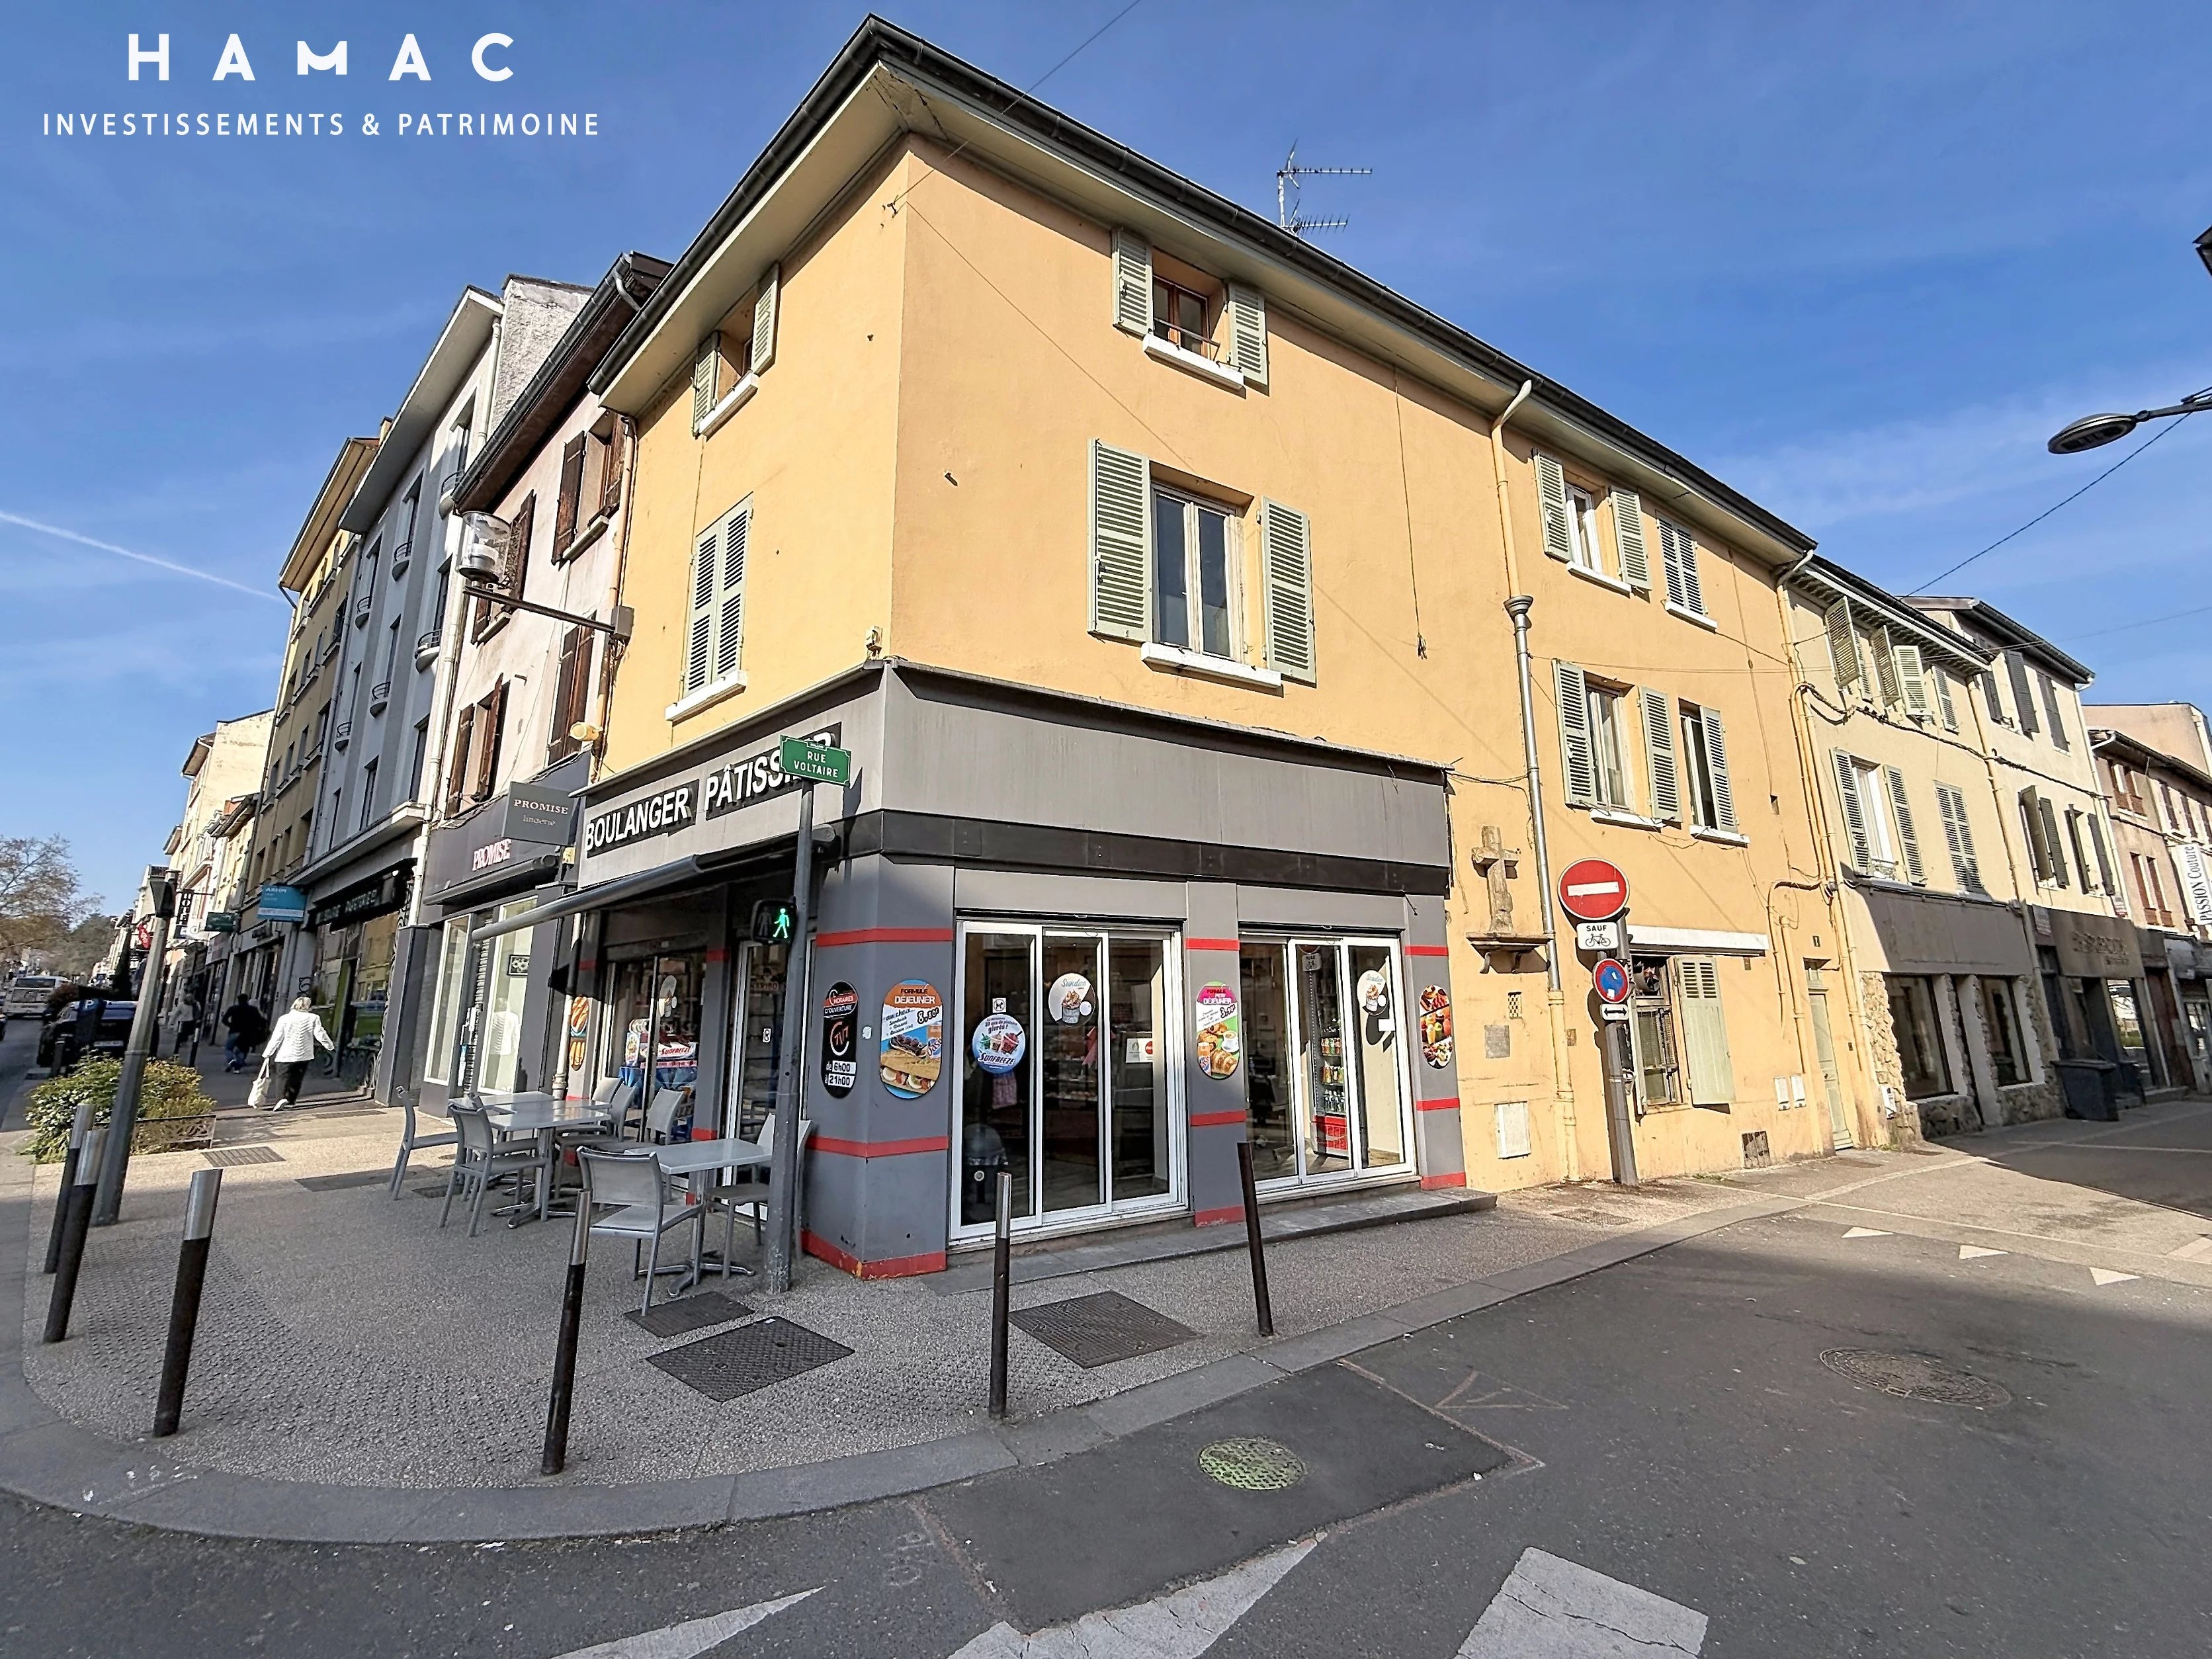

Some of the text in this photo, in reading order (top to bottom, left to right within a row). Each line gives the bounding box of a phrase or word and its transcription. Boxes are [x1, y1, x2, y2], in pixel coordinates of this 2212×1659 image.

[807, 751, 826, 763] RUE
[794, 760, 839, 778] VOLTAIRE
[585, 732, 831, 851] BOULANGER PÂTISS
[514, 799, 568, 815] PROMISE
[472, 838, 512, 871] PROMISE
[2184, 846, 2212, 921] PASSION Couture
[833, 996, 854, 1004] HORAIRES
[825, 1005, 853, 1014] D'OUVERTURE
[979, 1052, 1015, 1064] SUNFREEZE
[833, 1062, 851, 1072] 6h00
[830, 1076, 850, 1085] 21h00
